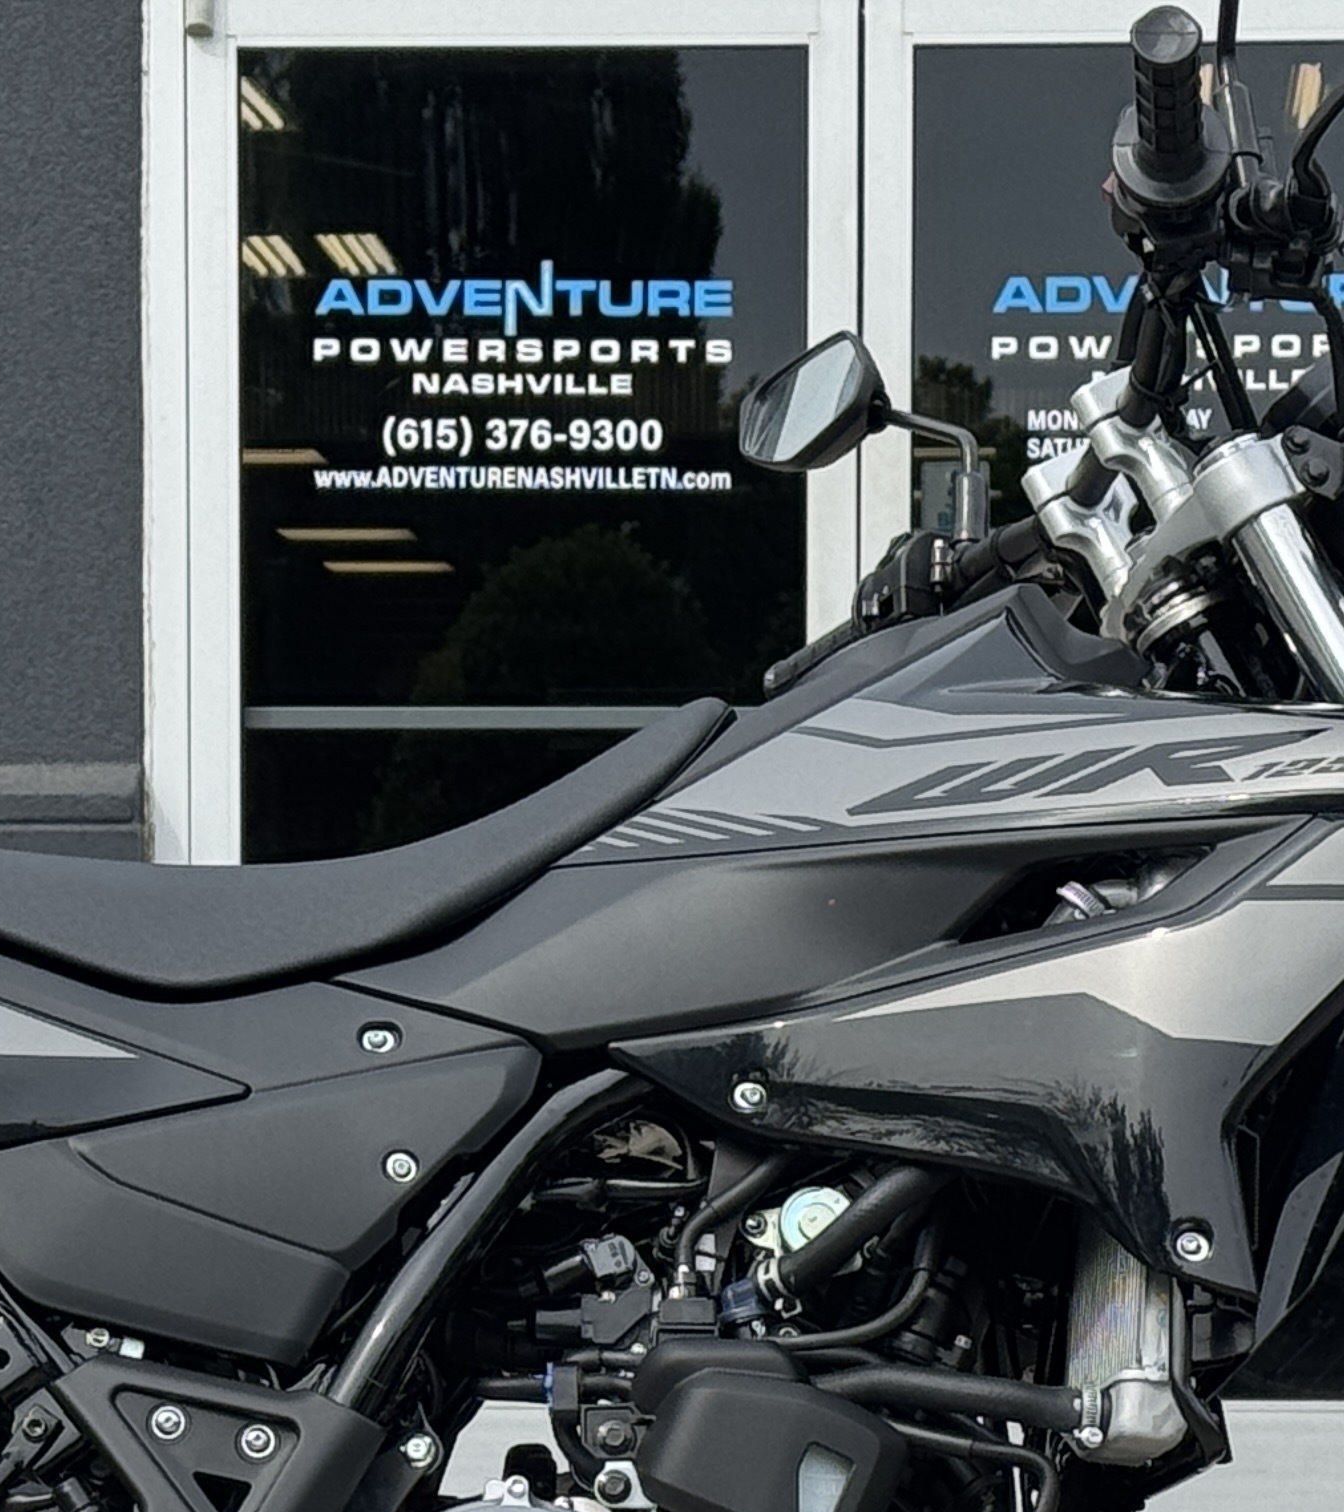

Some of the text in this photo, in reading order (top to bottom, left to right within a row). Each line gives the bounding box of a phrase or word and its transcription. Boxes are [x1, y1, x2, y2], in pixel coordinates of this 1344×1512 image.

[315, 259, 733, 336] ADVENTURE
[313, 338, 733, 363] POWERSPORTS
[412, 373, 633, 396] NASHVILLE
[382, 416, 664, 456] (615) 376-9300
[314, 466, 732, 491] www.ADVENTURENASHVILLETN.com
[846, 726, 1333, 816] WR
